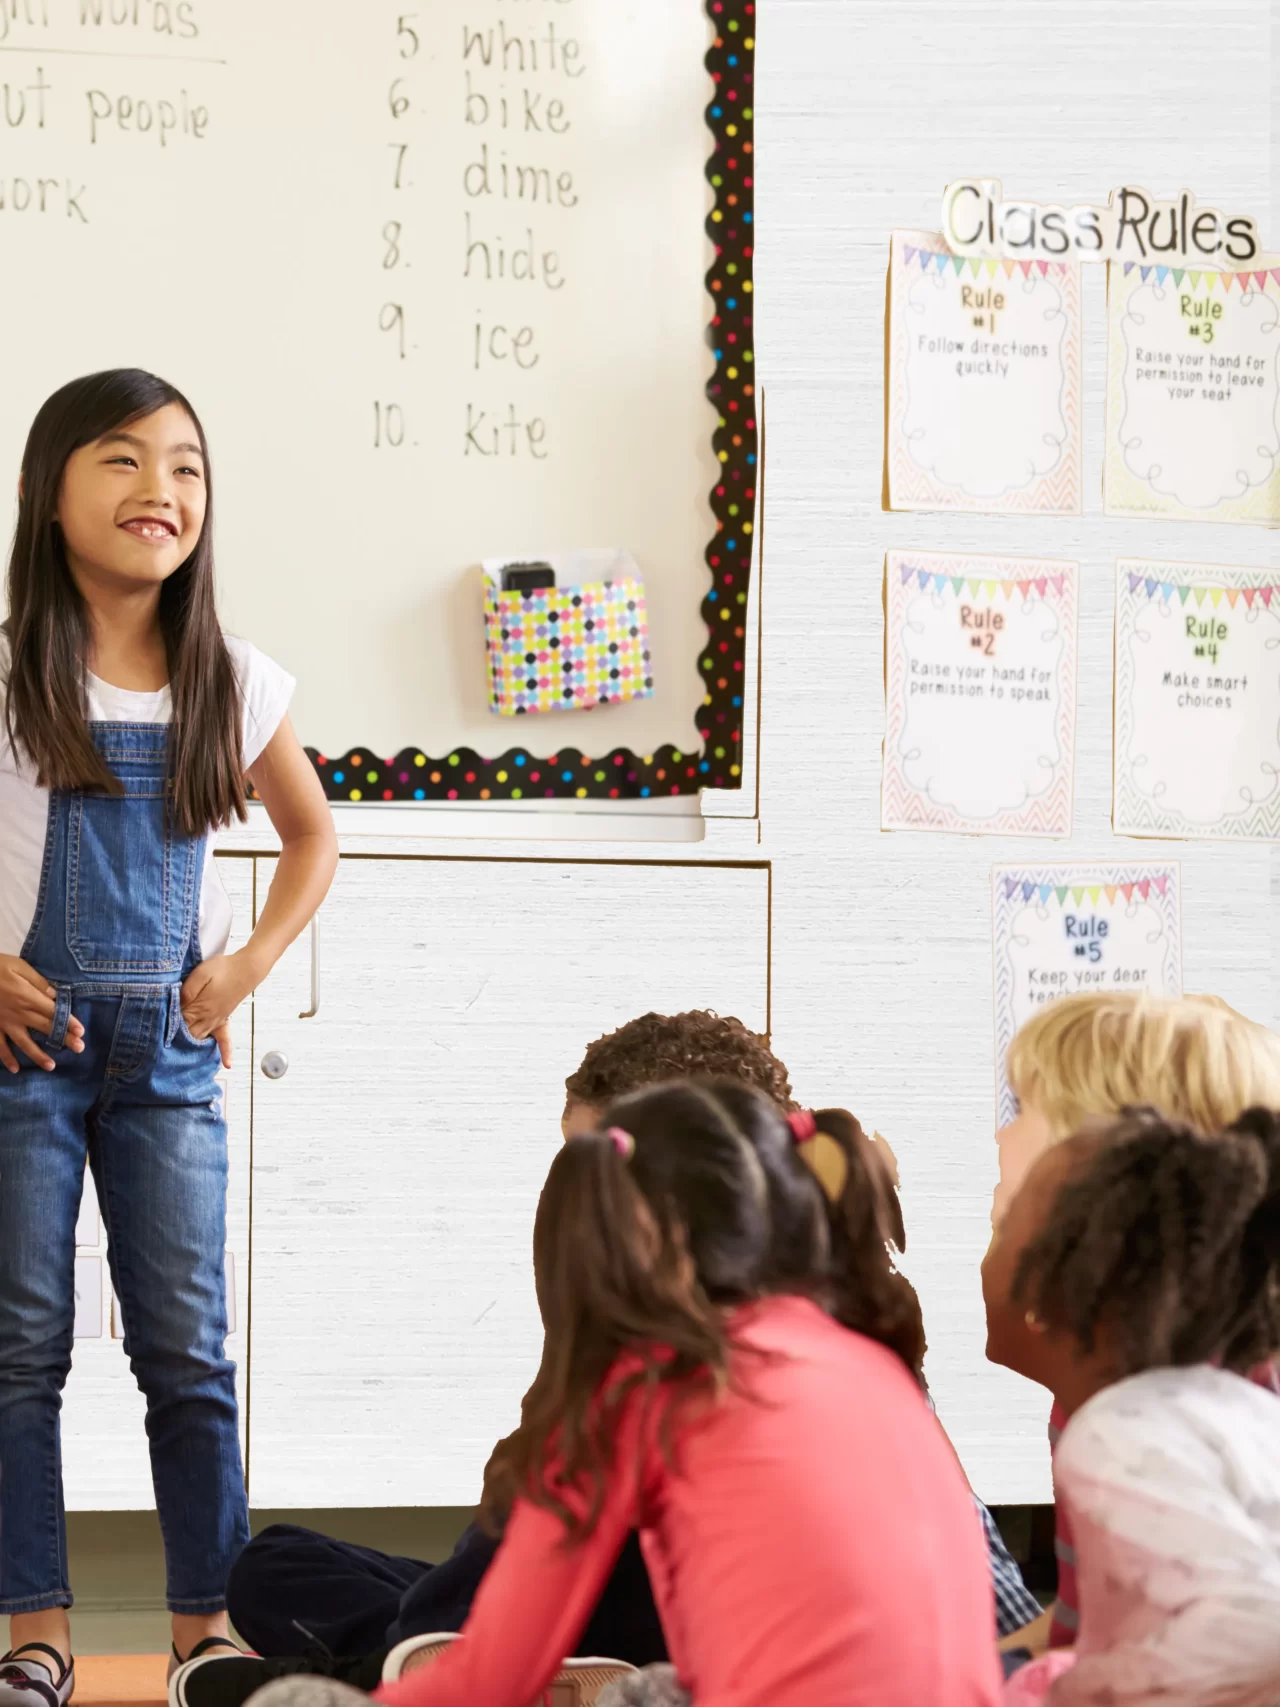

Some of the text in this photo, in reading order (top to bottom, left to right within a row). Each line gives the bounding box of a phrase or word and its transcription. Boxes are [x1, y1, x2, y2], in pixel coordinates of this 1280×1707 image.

[462, 20, 587, 78] white
[464, 70, 571, 133] bike
[85, 87, 209, 147] people
[463, 142, 579, 207] dime
[949, 180, 1257, 261] Class Rules
[463, 211, 566, 290] hide
[961, 284, 1005, 309] Rule
[1180, 293, 1223, 319] Rule
[972, 313, 996, 334] #1
[1188, 322, 1214, 344] #3
[474, 308, 540, 370] ice
[918, 335, 1049, 357] Follow directions
[955, 359, 1009, 378] quickly
[1135, 347, 1266, 370] Raise your hand for
[1136, 367, 1265, 388] permission to leave
[1167, 386, 1231, 402] your seat
[464, 403, 549, 460] kite
[960, 605, 1004, 630] Rule
[1185, 615, 1228, 640] Rule
[970, 632, 996, 656] #2
[1194, 642, 1218, 665] #4
[910, 659, 1052, 684] Raise your hand for
[1161, 671, 1248, 691] Make smart
[910, 681, 1051, 703] permission to speak
[1176, 691, 1232, 709] choices
[1064, 914, 1108, 938] Rule
[1075, 941, 1102, 963] #5
[1027, 965, 1148, 988] Keep your dear
